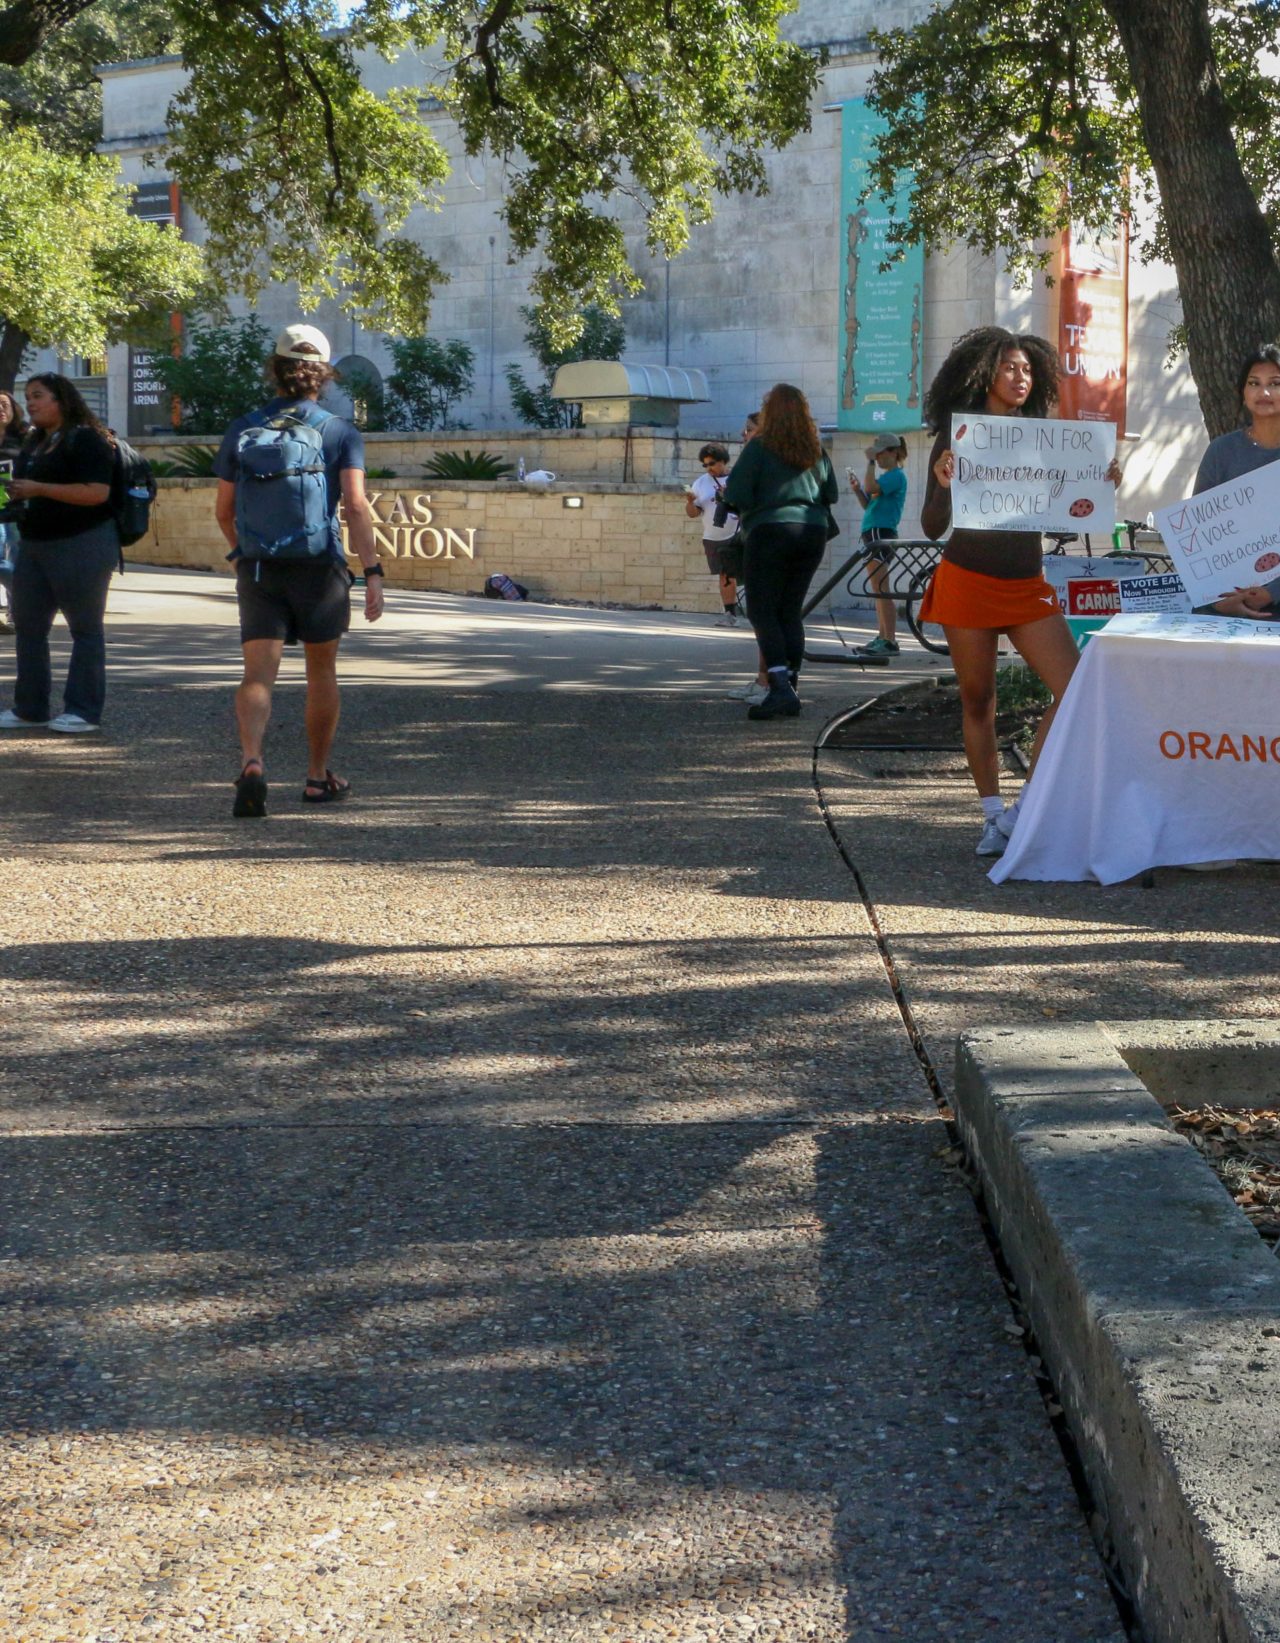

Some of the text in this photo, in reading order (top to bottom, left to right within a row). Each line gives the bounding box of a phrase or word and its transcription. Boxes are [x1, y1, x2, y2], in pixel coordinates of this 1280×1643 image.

[972, 422, 1094, 453] CHIP IN FOR
[957, 456, 1108, 499] Democracy with
[961, 489, 1052, 516] a COOKIE!
[341, 526, 477, 560] UNION
[1131, 577, 1160, 589] VOTE
